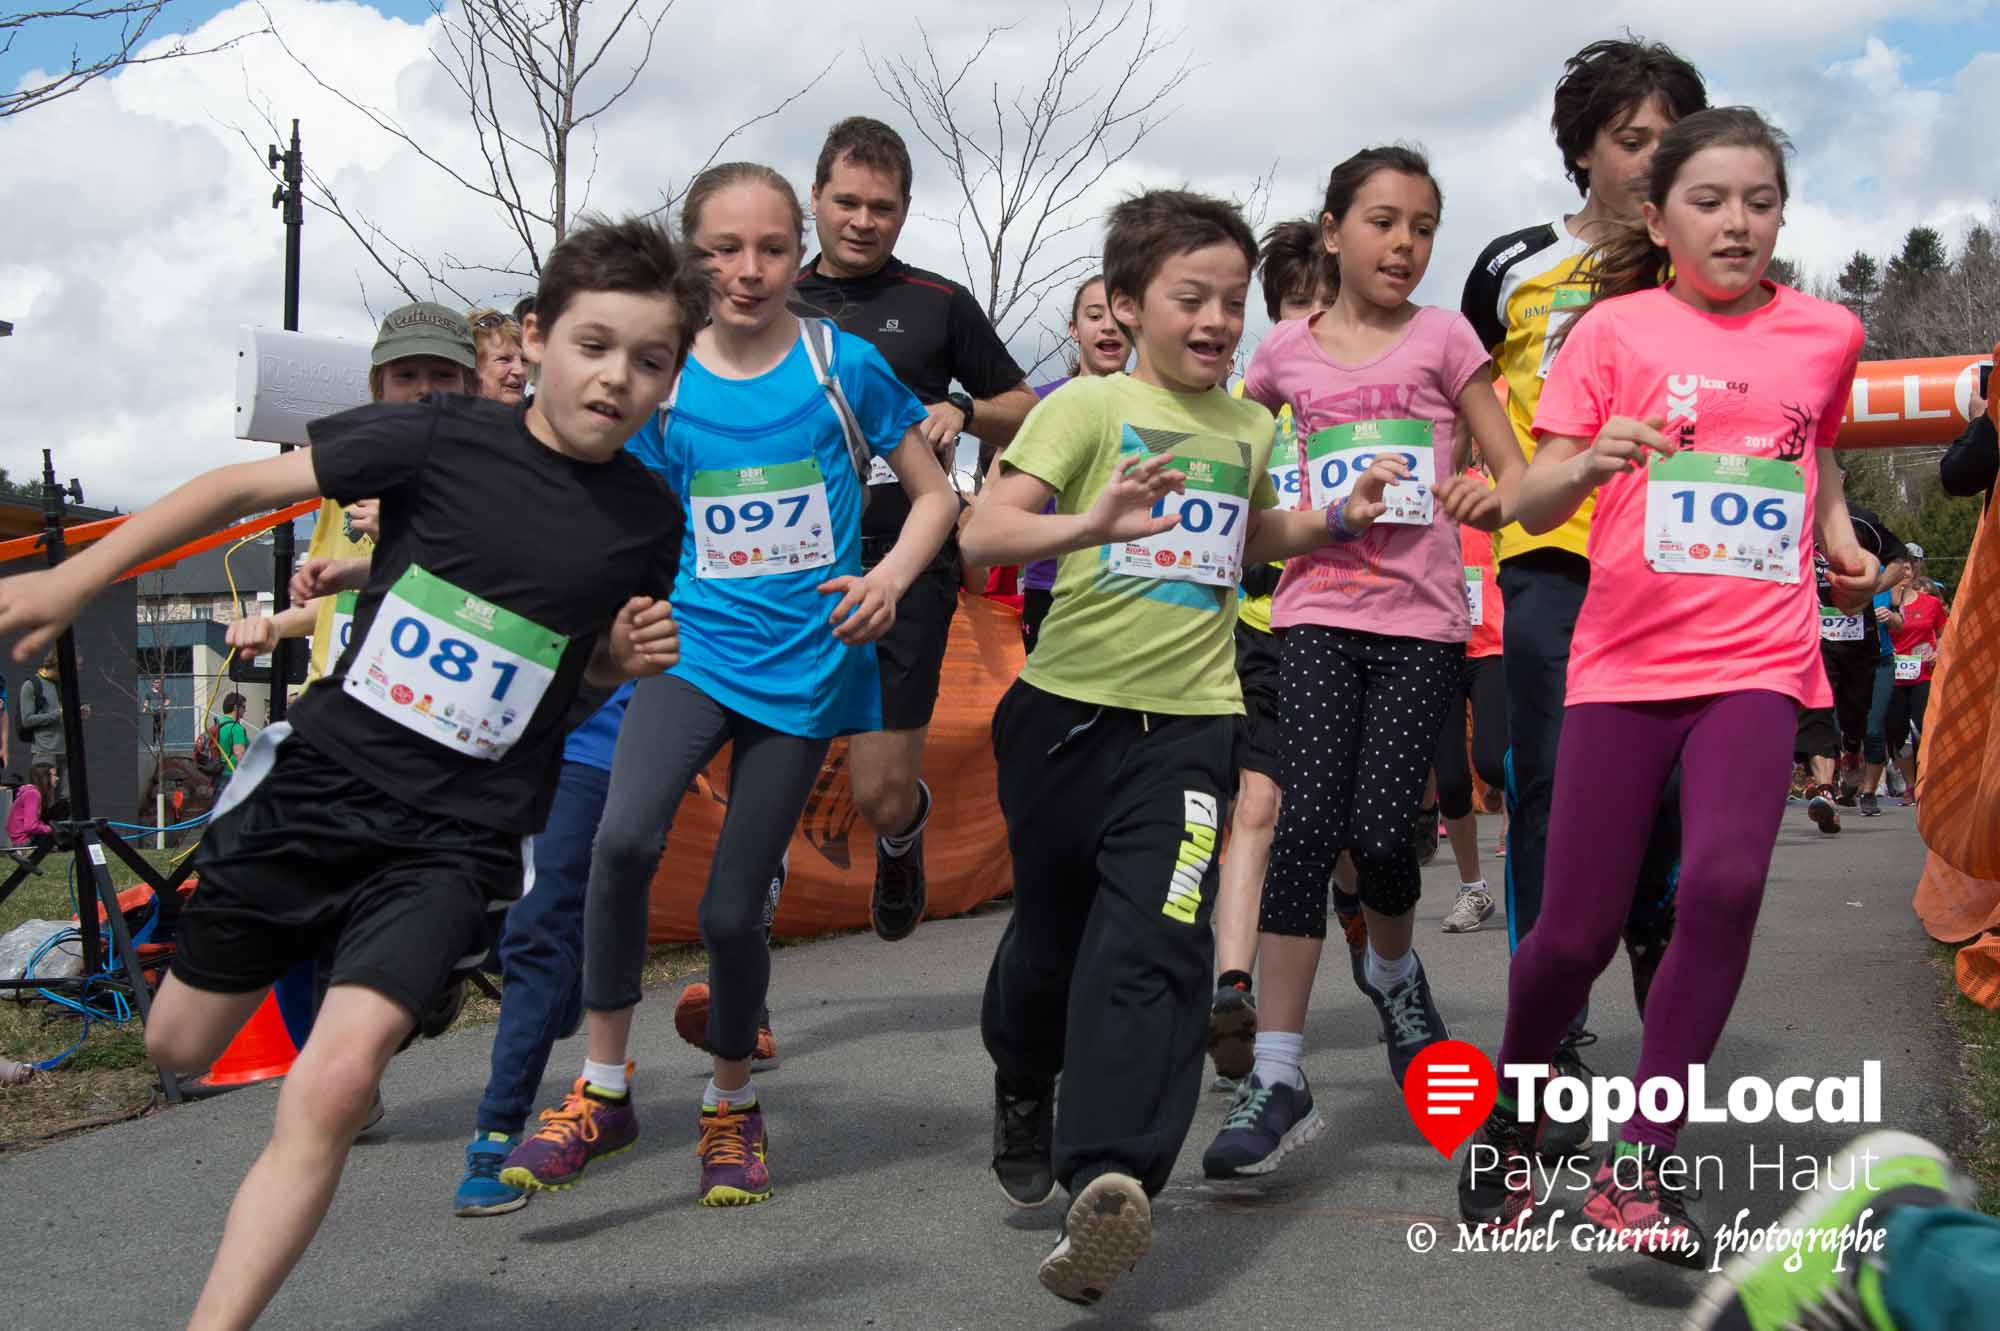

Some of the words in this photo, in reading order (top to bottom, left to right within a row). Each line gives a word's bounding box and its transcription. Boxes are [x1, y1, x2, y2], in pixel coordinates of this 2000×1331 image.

[705, 494, 810, 535] 097
[1671, 490, 1788, 531] 106
[1822, 616, 1858, 628] 079
[390, 616, 518, 701] 081
